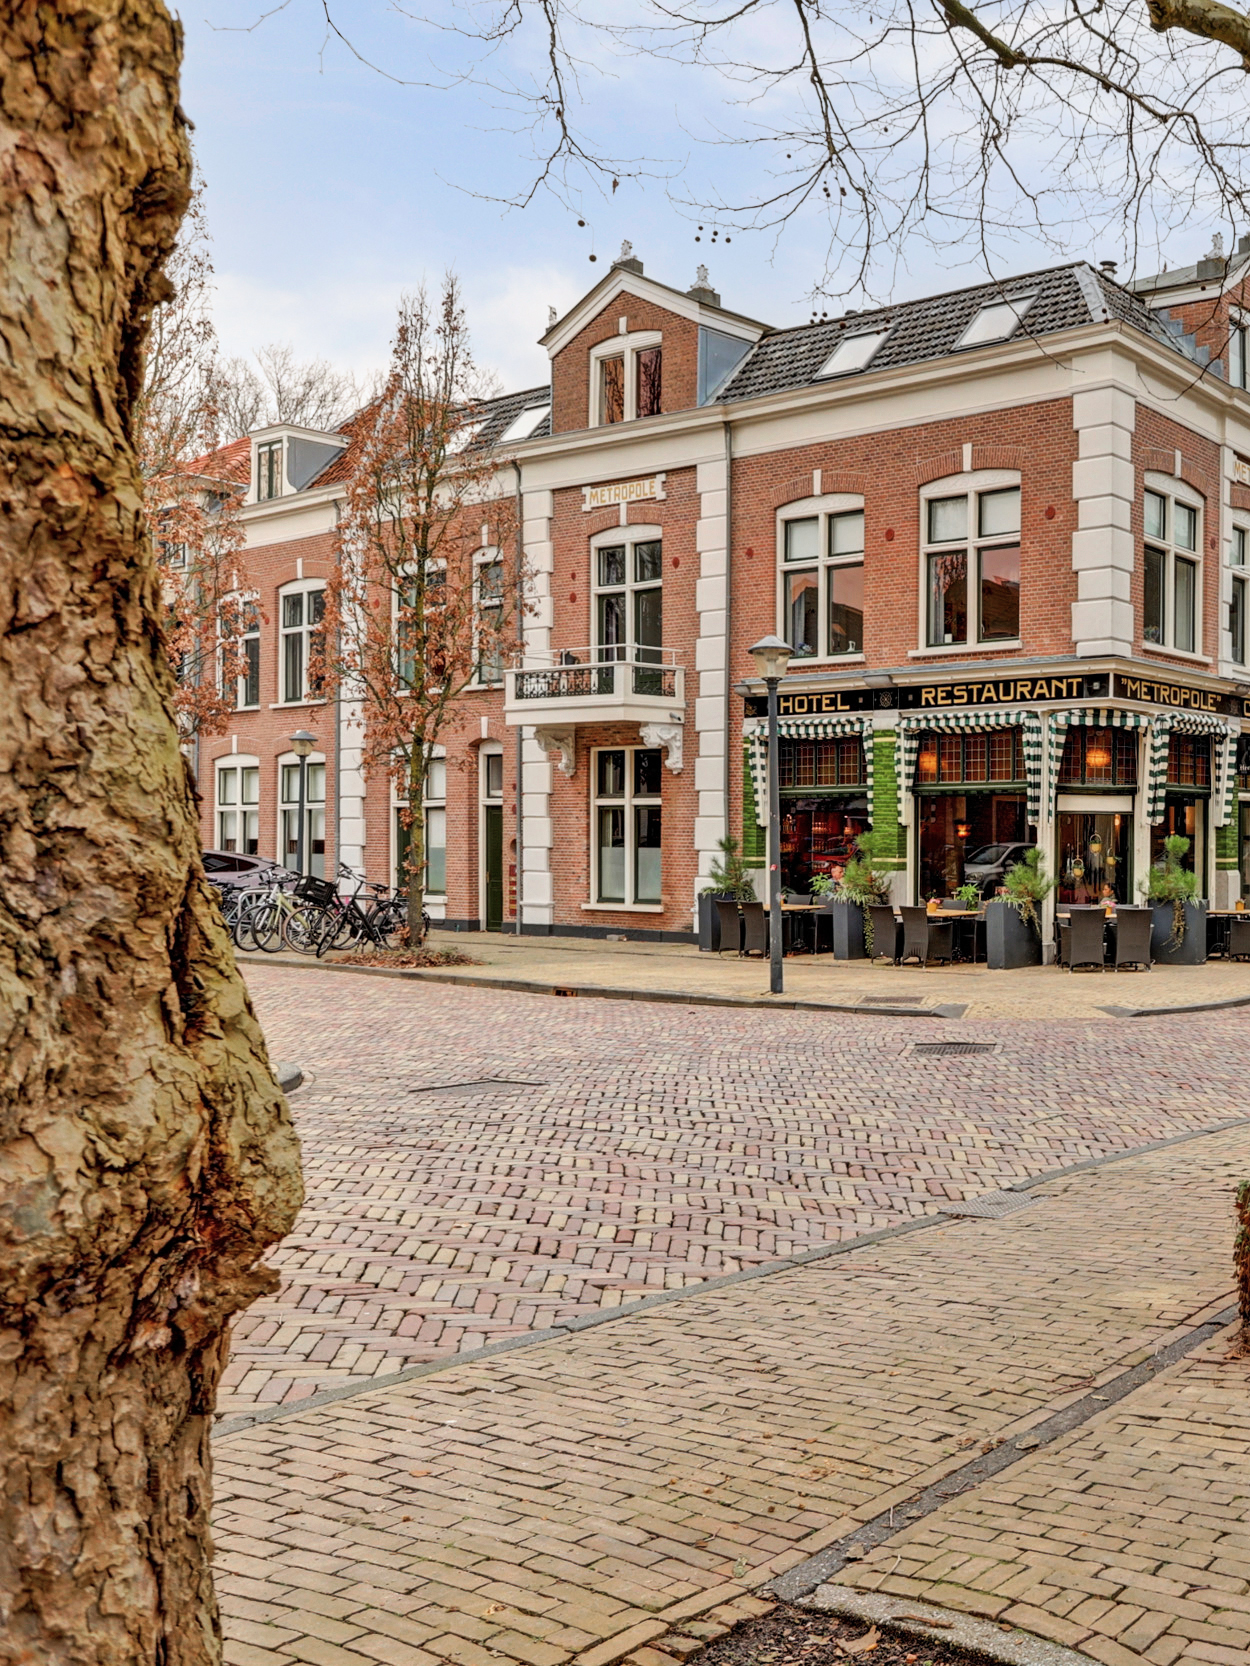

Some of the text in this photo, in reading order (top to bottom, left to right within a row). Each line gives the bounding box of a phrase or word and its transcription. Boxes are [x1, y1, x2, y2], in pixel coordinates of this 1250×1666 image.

[590, 480, 656, 505] METROPOLE
[779, 693, 850, 714] HOTEL
[921, 677, 1082, 706] RESTAURANT
